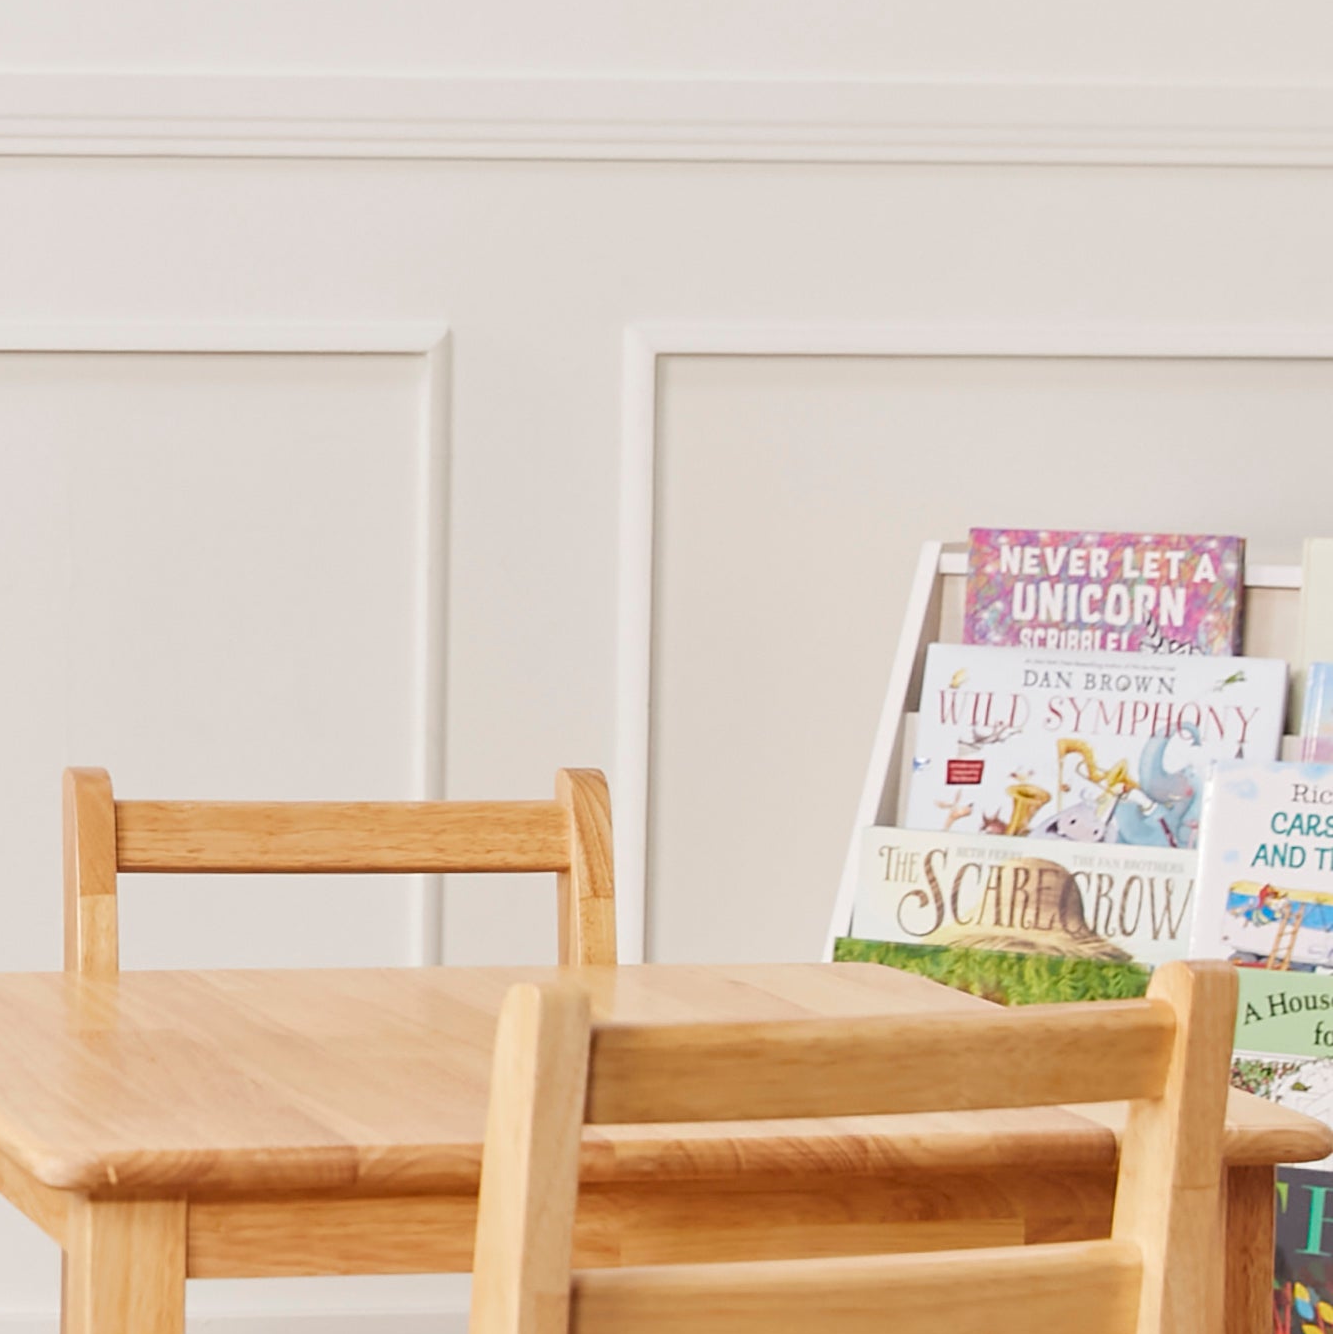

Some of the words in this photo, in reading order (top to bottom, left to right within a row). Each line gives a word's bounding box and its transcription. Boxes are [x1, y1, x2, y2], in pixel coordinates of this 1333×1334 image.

[999, 544, 1108, 579] NEVER
[1122, 547, 1184, 581] LET
[1192, 553, 1218, 584] A
[1011, 581, 1187, 628] UNICORN
[1023, 669, 1073, 689] DAN
[1083, 672, 1176, 695] BROWN
[938, 689, 1031, 729] WILD
[1042, 695, 1260, 745] SYMPHONY
[879, 845, 920, 884] THE
[1250, 842, 1307, 869] AND
[1243, 1002, 1264, 1026] A
[1266, 991, 1333, 1018] Hous
